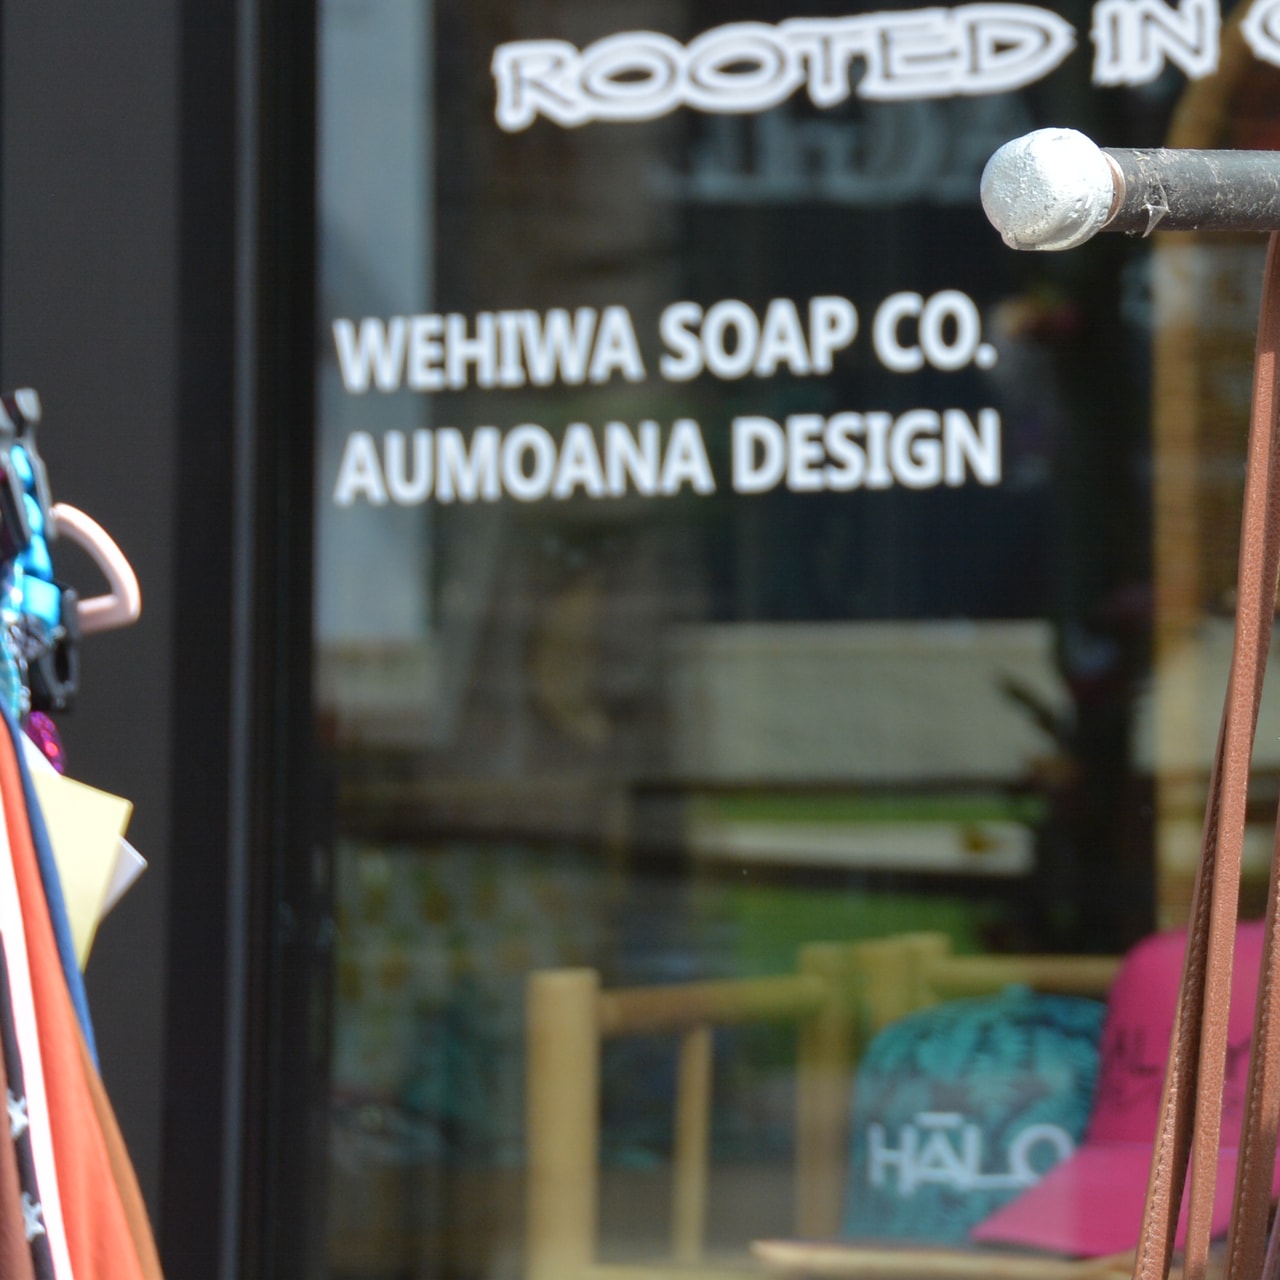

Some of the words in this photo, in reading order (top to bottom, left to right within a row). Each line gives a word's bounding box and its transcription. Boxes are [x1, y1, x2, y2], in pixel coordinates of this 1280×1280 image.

[493, 2, 1076, 131] ROOTED
[332, 305, 646, 394] WEHIWA
[659, 296, 857, 382] SOAP
[873, 289, 998, 373] CO.
[334, 418, 715, 506] AUMOANA
[732, 407, 1003, 493] DESIGN
